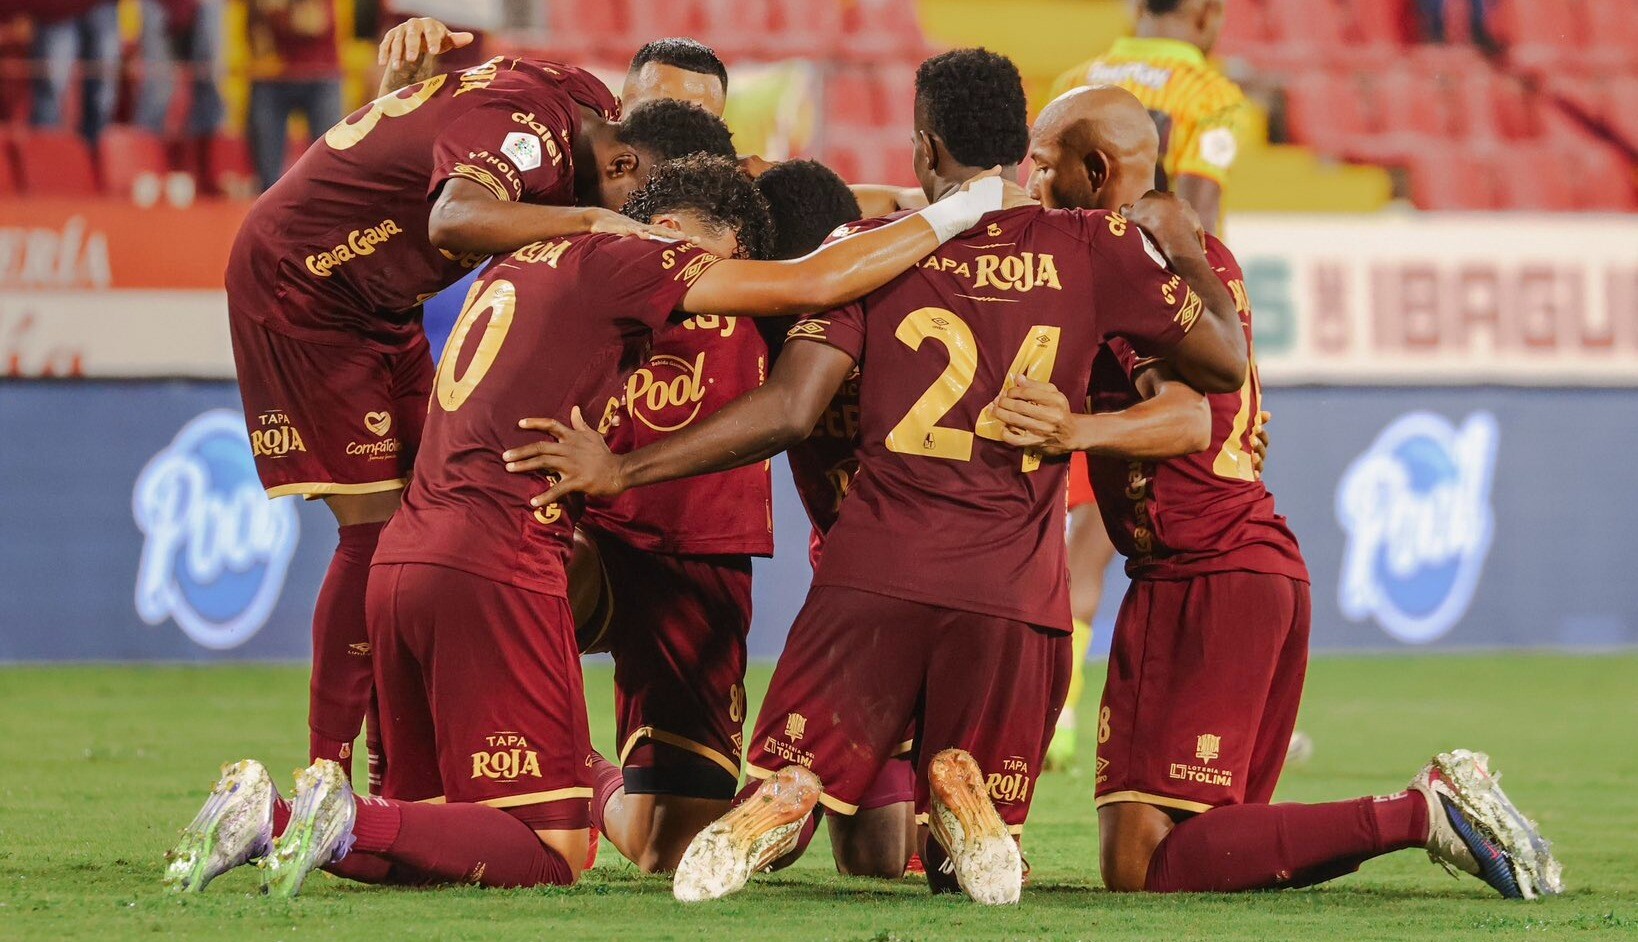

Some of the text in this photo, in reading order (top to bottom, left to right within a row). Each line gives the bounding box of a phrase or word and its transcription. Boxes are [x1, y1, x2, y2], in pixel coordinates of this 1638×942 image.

[916, 251, 1062, 292] APA ROJA
[1370, 260, 1638, 351] IBAGU
[626, 351, 706, 418] Pool
[885, 306, 1061, 473] 24
[258, 413, 290, 426] TAPA
[251, 425, 306, 457] ROJA
[485, 735, 528, 747] TAPA
[470, 748, 543, 779] ROJA
[777, 746, 813, 769] TOLIMA
[1003, 759, 1028, 773] TAPA
[985, 772, 1030, 803] ROJA
[1187, 770, 1232, 787] TOLIMA
